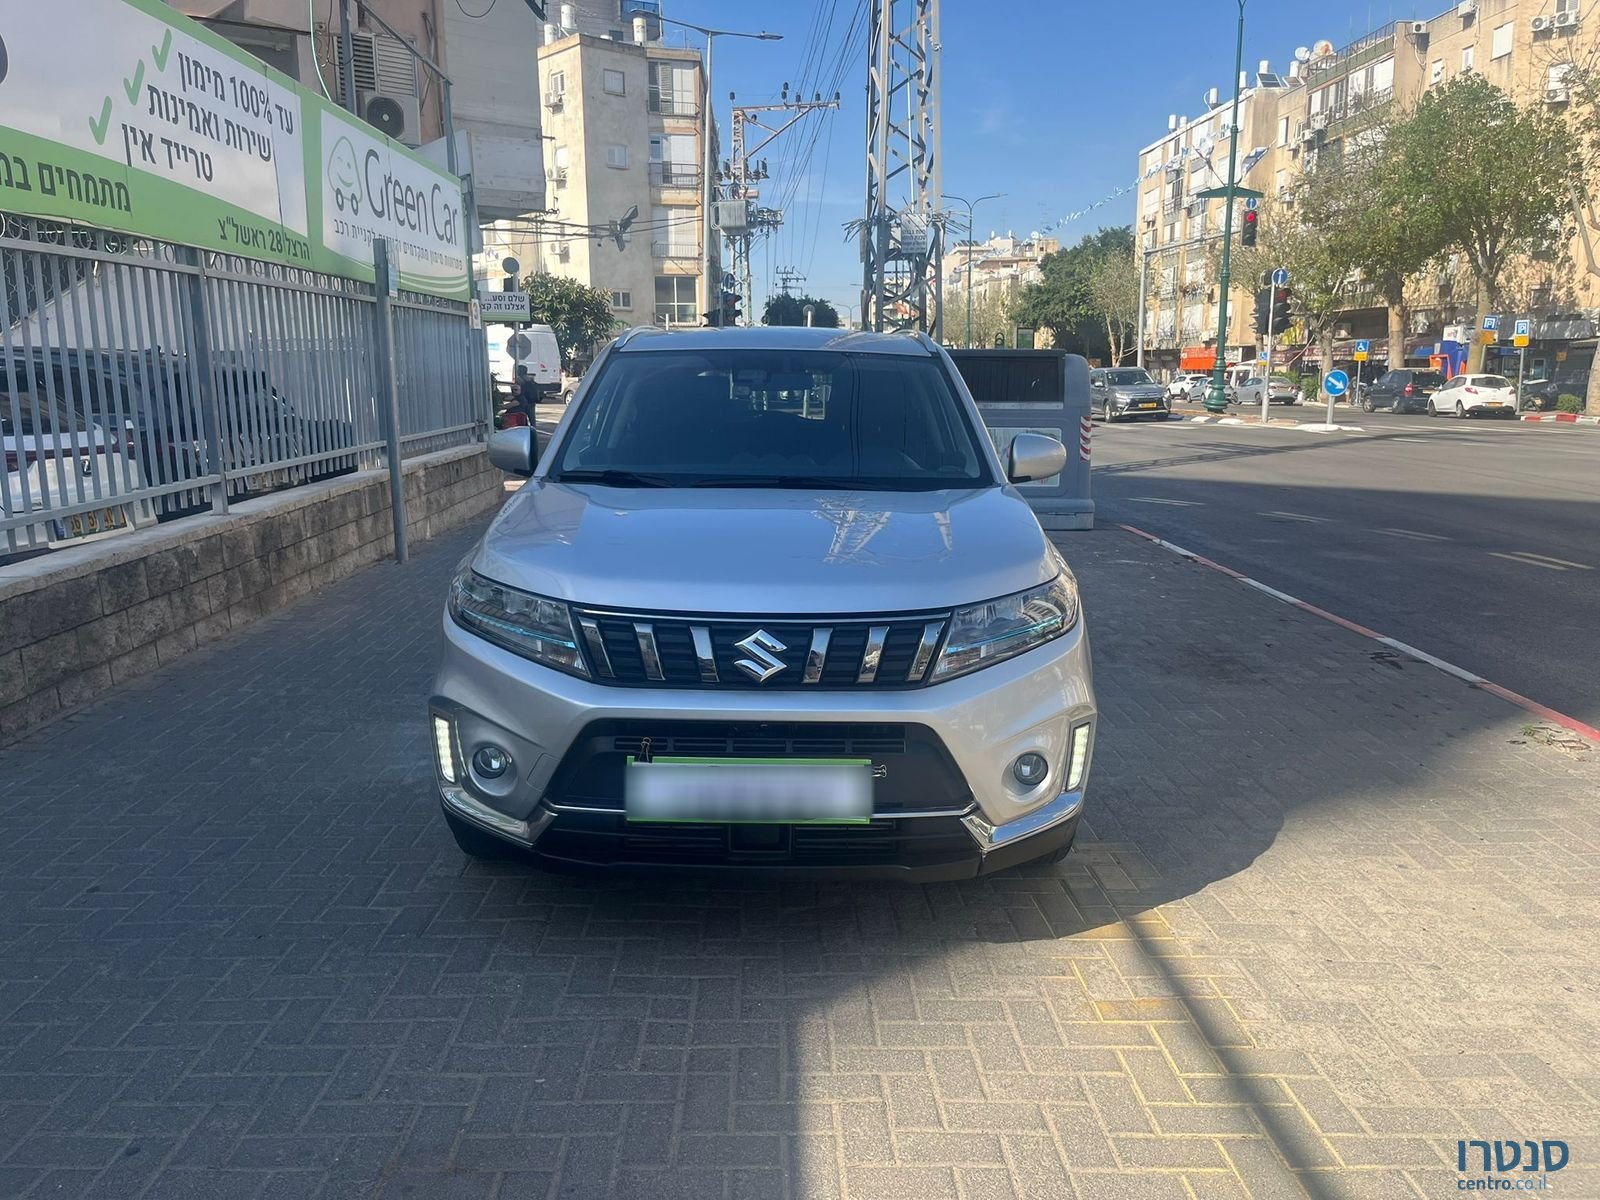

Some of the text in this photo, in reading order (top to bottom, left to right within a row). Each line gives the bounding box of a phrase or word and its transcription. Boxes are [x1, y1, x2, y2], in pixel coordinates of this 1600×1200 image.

[177, 51, 294, 135] עד 100% מימון
[147, 84, 272, 162] שירות ואמינות
[121, 122, 213, 182] טרייד אין
[37, 162, 132, 212] מתמחים
[365, 149, 458, 246] Green Car
[218, 215, 311, 261] הרצל 28 ראשל"צ
[334, 219, 350, 237] רכב
[504, 302, 526, 311] אצלנו
[507, 294, 525, 302] שלם
